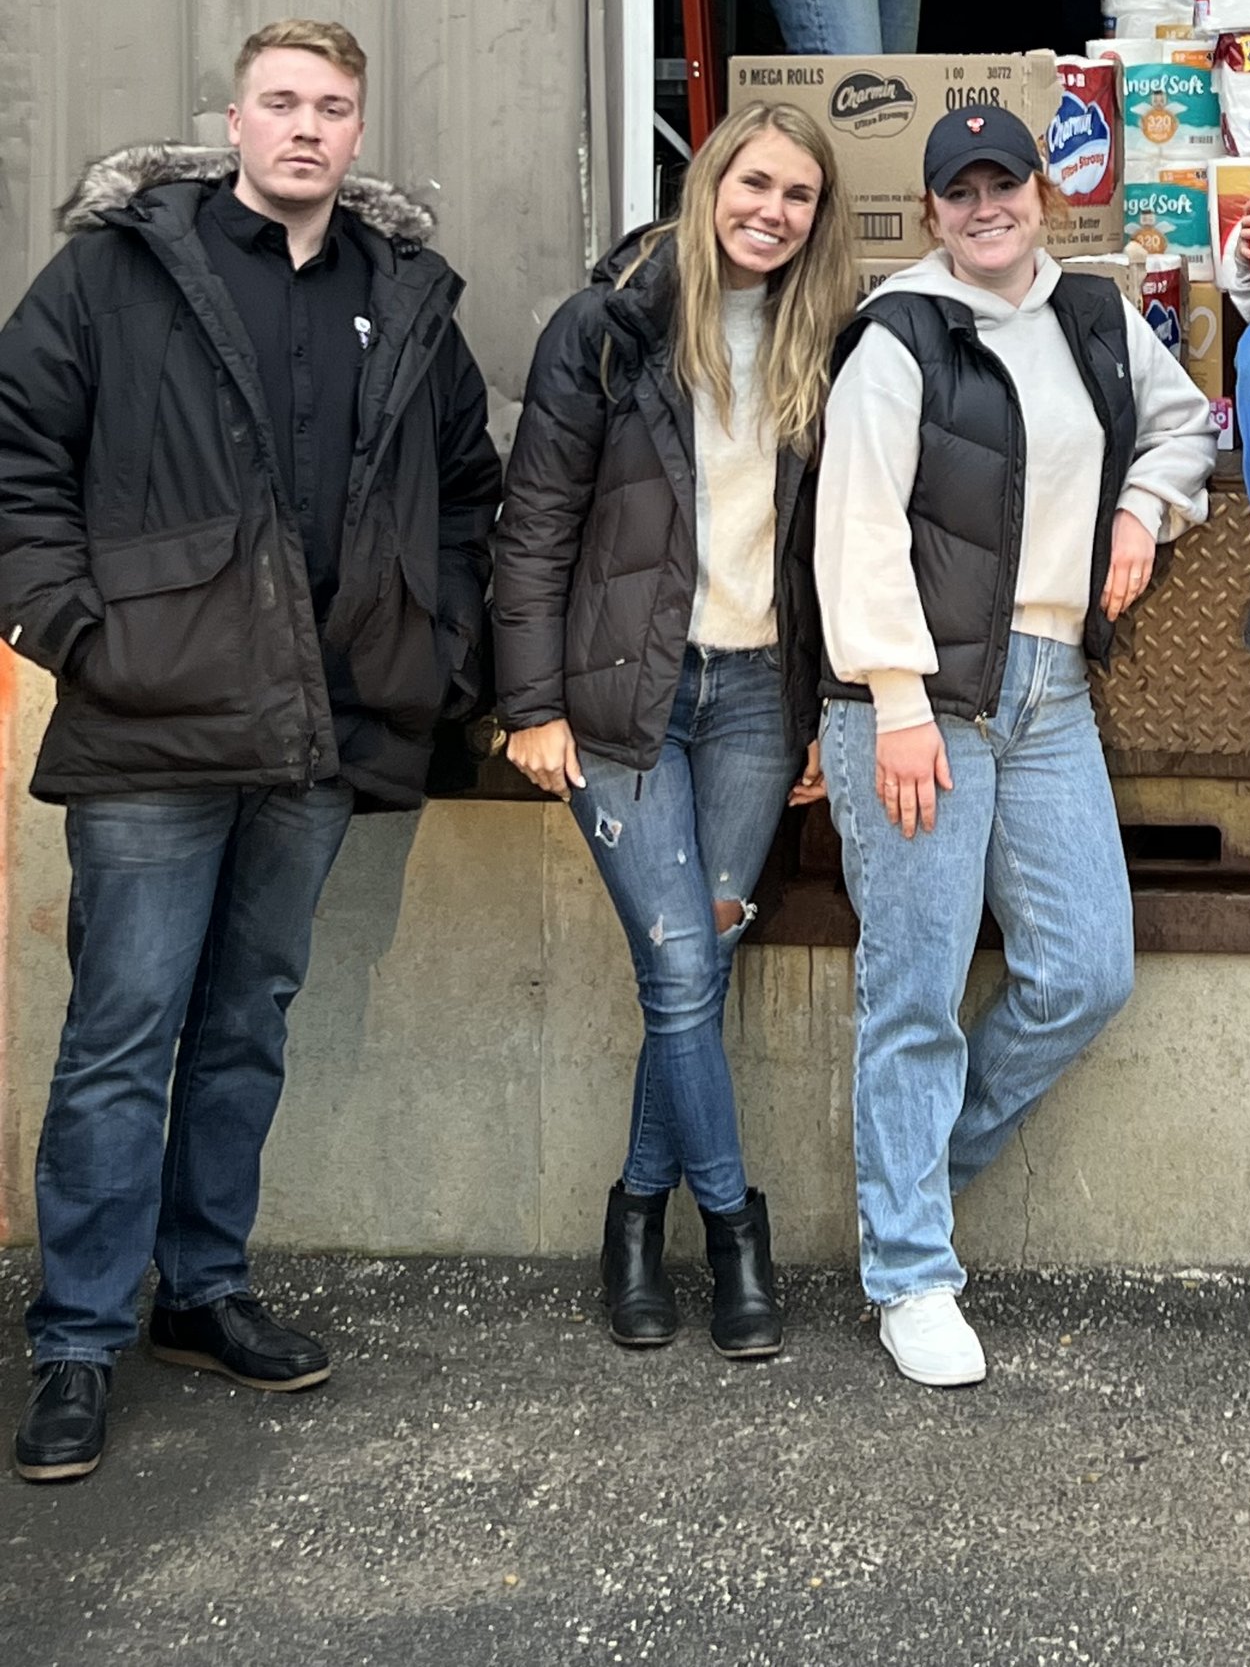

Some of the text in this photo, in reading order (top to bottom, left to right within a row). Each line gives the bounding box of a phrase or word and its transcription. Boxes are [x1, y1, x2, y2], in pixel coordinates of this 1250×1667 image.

[739, 68, 824, 85] 9 MEGA ROLLS
[1166, 74, 1204, 94] Soft
[838, 81, 896, 112] Charmin
[854, 111, 909, 130] Ultra Strong
[1147, 115, 1171, 127] 320
[1050, 113, 1093, 153] Charmin
[1078, 153, 1105, 170] Strong
[1158, 194, 1193, 215] Soft
[1079, 216, 1101, 230] Better
